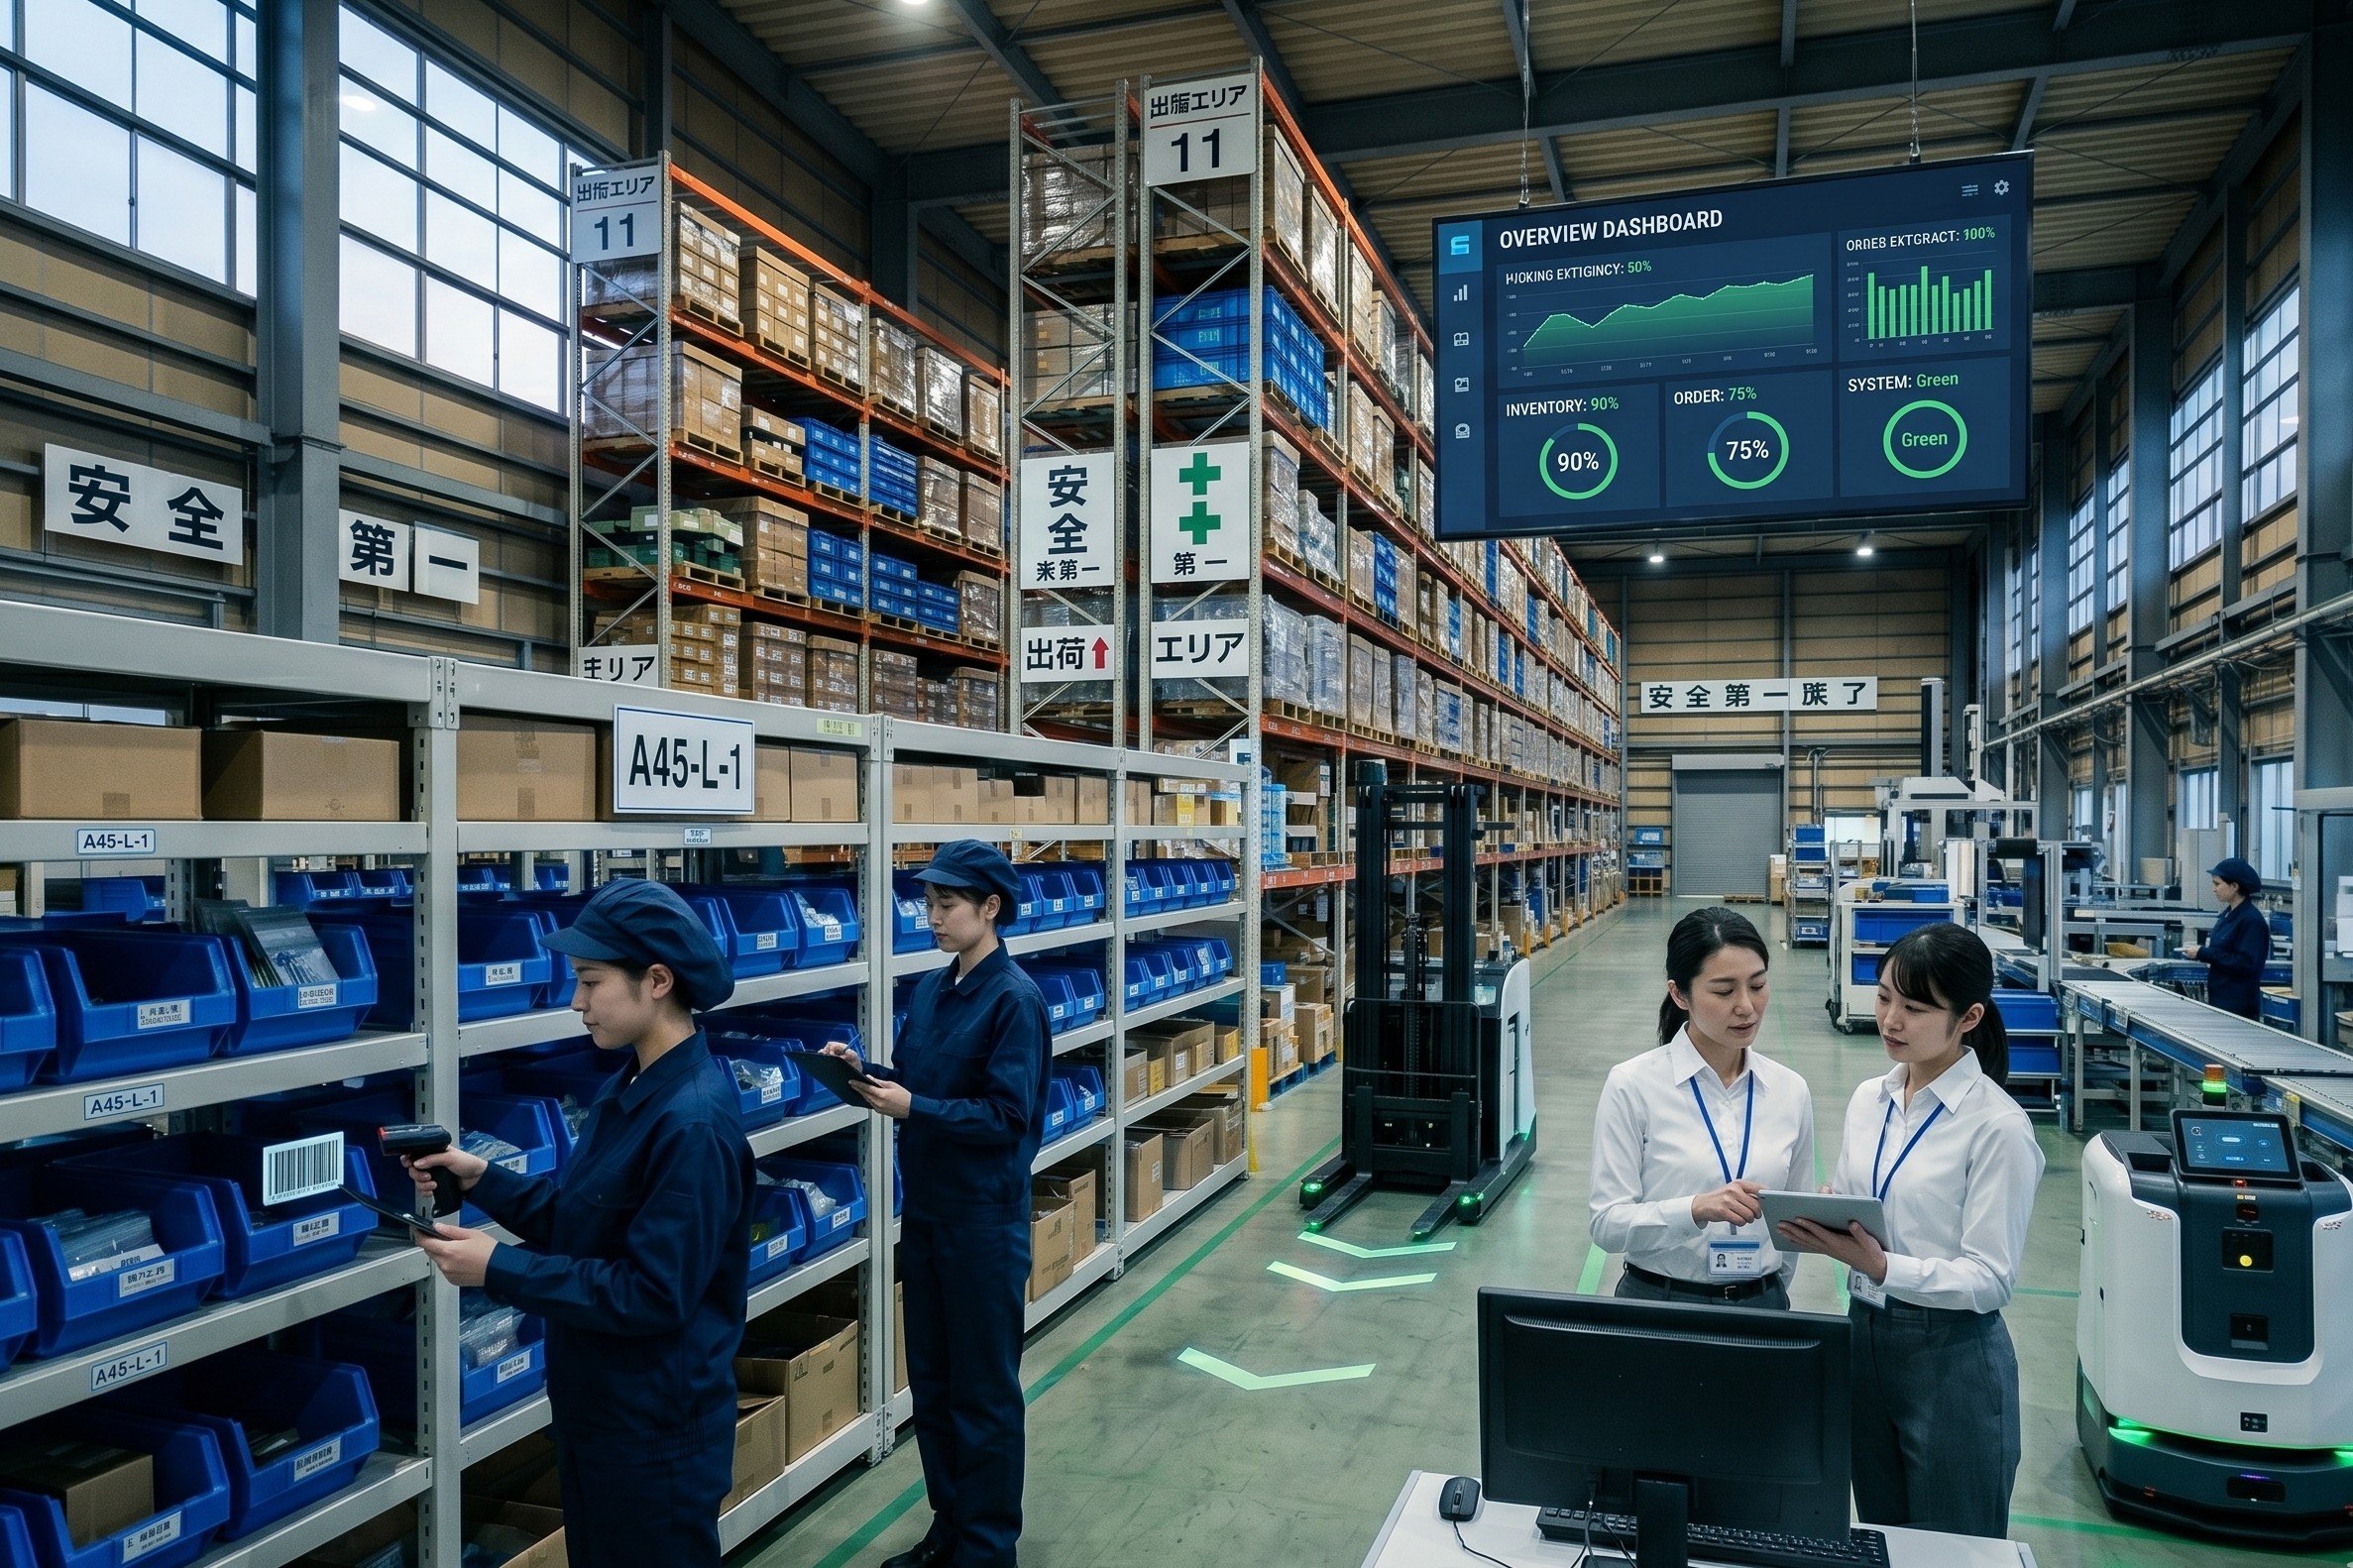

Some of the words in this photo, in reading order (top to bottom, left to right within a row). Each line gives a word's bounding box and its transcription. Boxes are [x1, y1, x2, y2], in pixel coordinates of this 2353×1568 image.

[1171, 128, 1220, 172] 11
[595, 213, 634, 250] 11
[1500, 222, 1598, 249] OVERVIEW
[1603, 209, 1724, 239] DASHBOARD
[1963, 226, 1995, 241] 100%
[1627, 260, 1652, 275] 50%
[1848, 375, 1912, 392] SYSTEM:
[1916, 372, 1960, 389] Green
[1506, 398, 1587, 416] INVENTORY:
[1591, 396, 1620, 411] 90%
[1673, 389, 1725, 405] ORDER:
[1728, 386, 1757, 401] 75%
[1726, 439, 1769, 460] 75%
[1901, 431, 1949, 448] Green
[1557, 451, 1600, 472] 90%
[67, 462, 225, 551] 安全
[349, 518, 469, 578] 第一
[1048, 464, 1088, 555] 安全
[1173, 551, 1228, 576] 第一
[1026, 636, 1085, 671] 出荷
[1156, 632, 1245, 664] エリア
[628, 734, 740, 790] A45-L-1
[83, 834, 149, 849] A45-L-1
[89, 1089, 159, 1115] A45-L-1
[95, 1349, 163, 1386] A45-L-1
